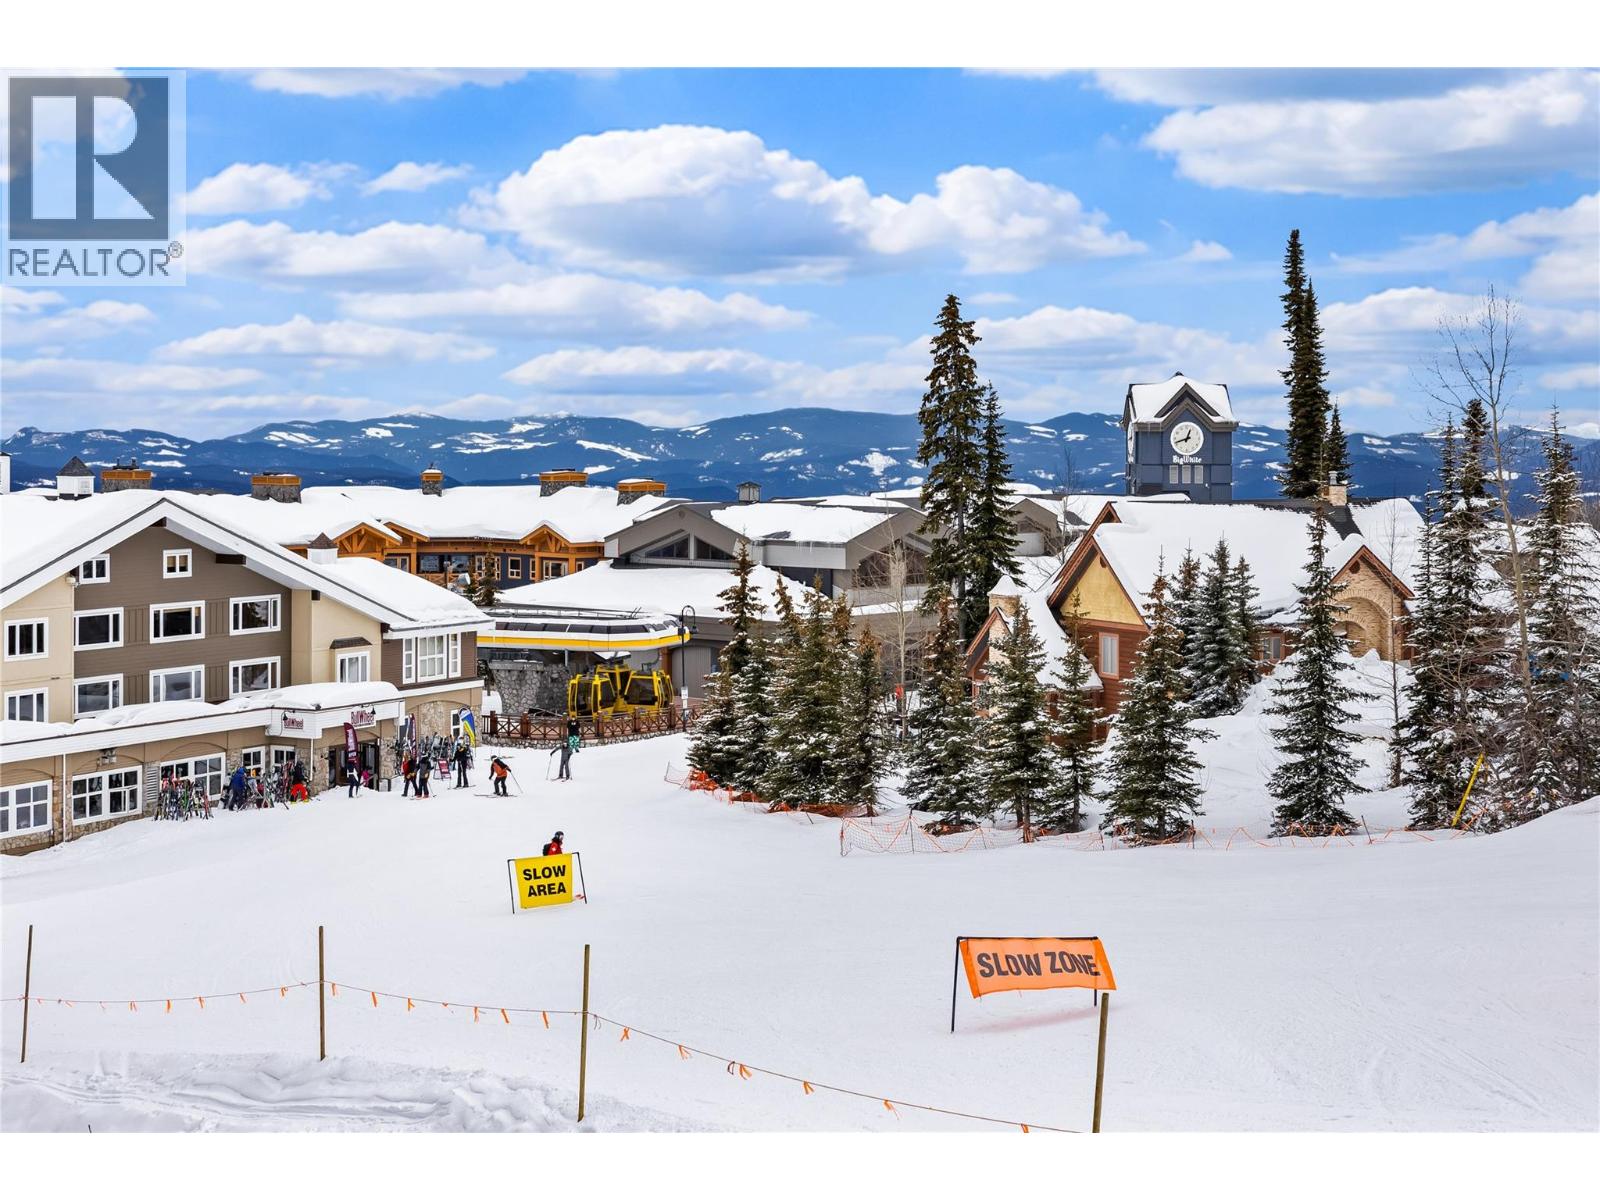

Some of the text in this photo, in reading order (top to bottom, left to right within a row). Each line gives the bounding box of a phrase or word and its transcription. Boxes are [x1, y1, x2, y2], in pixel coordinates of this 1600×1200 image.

[523, 865, 566, 881] SLOW
[528, 882, 567, 898] AREA
[977, 951, 1102, 978] SLOW ZONE
